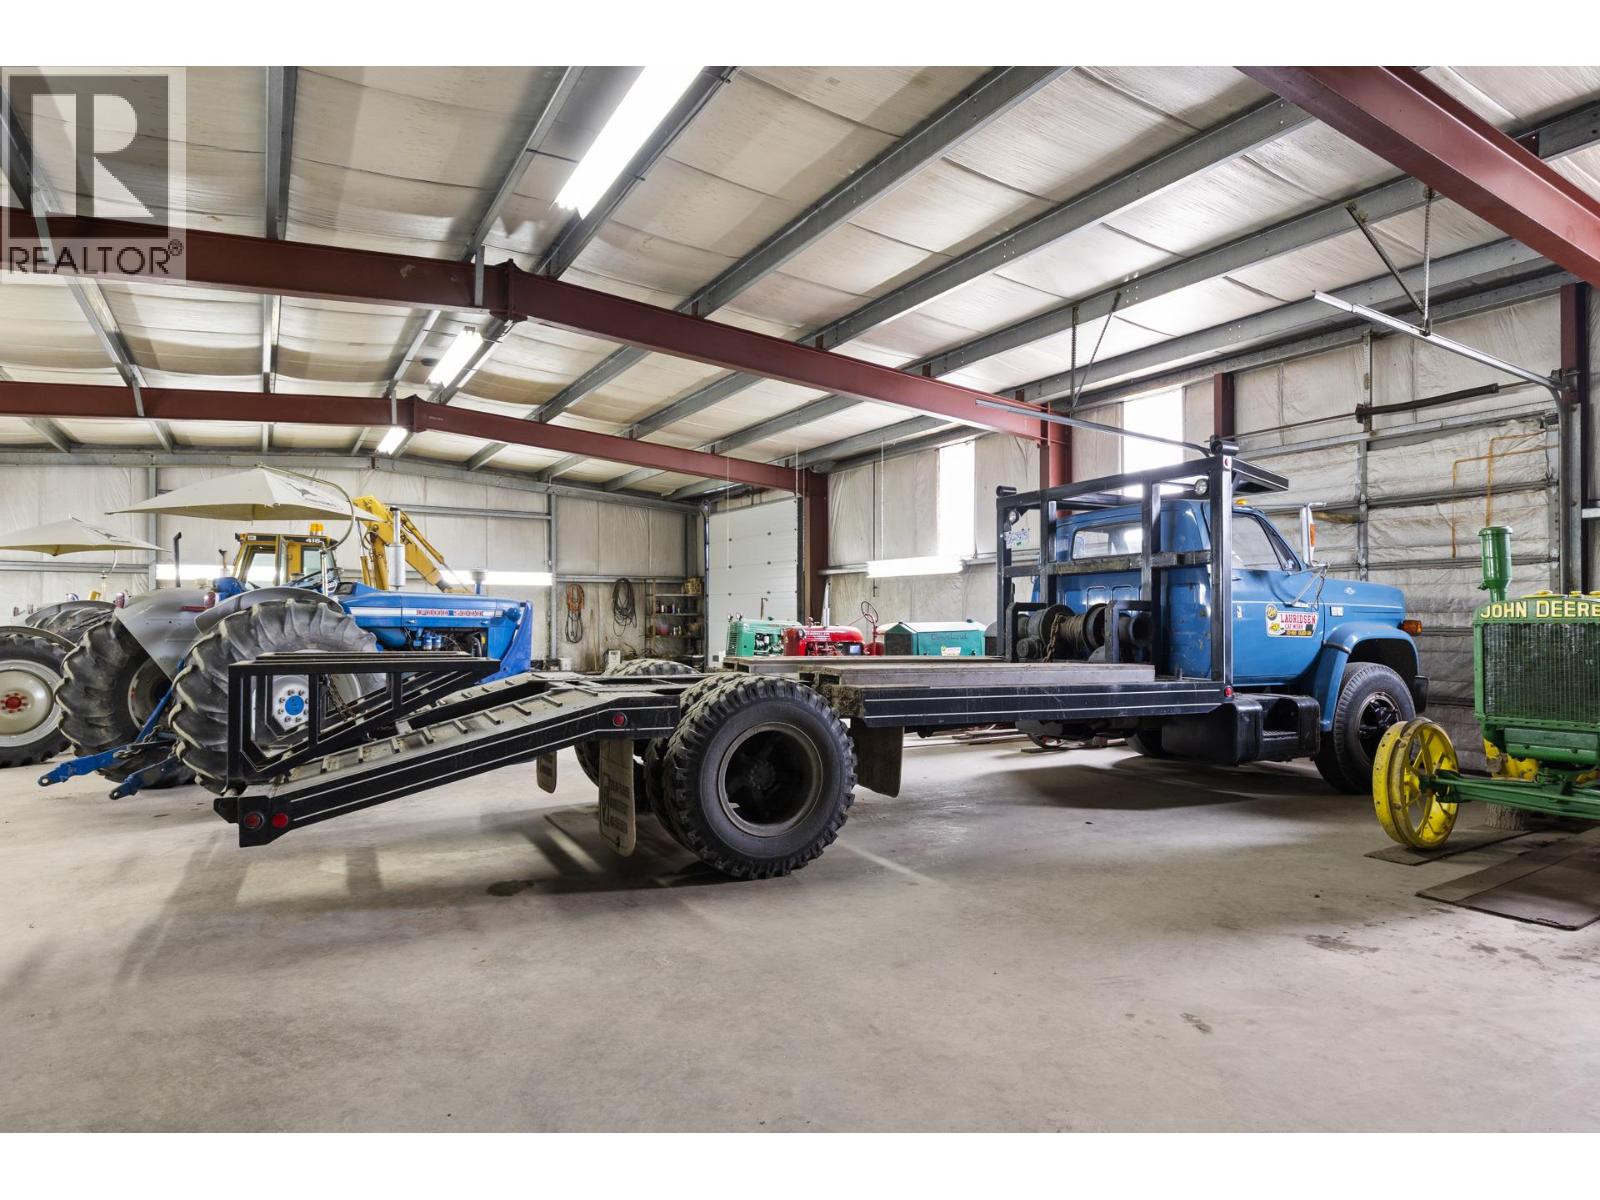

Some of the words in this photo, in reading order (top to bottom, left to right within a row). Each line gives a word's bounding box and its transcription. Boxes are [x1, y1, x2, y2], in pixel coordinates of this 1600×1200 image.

[1480, 601, 1527, 618] JOHN
[1536, 600, 1600, 618] DEERE
[1280, 613, 1316, 624] LAURIDSEN
